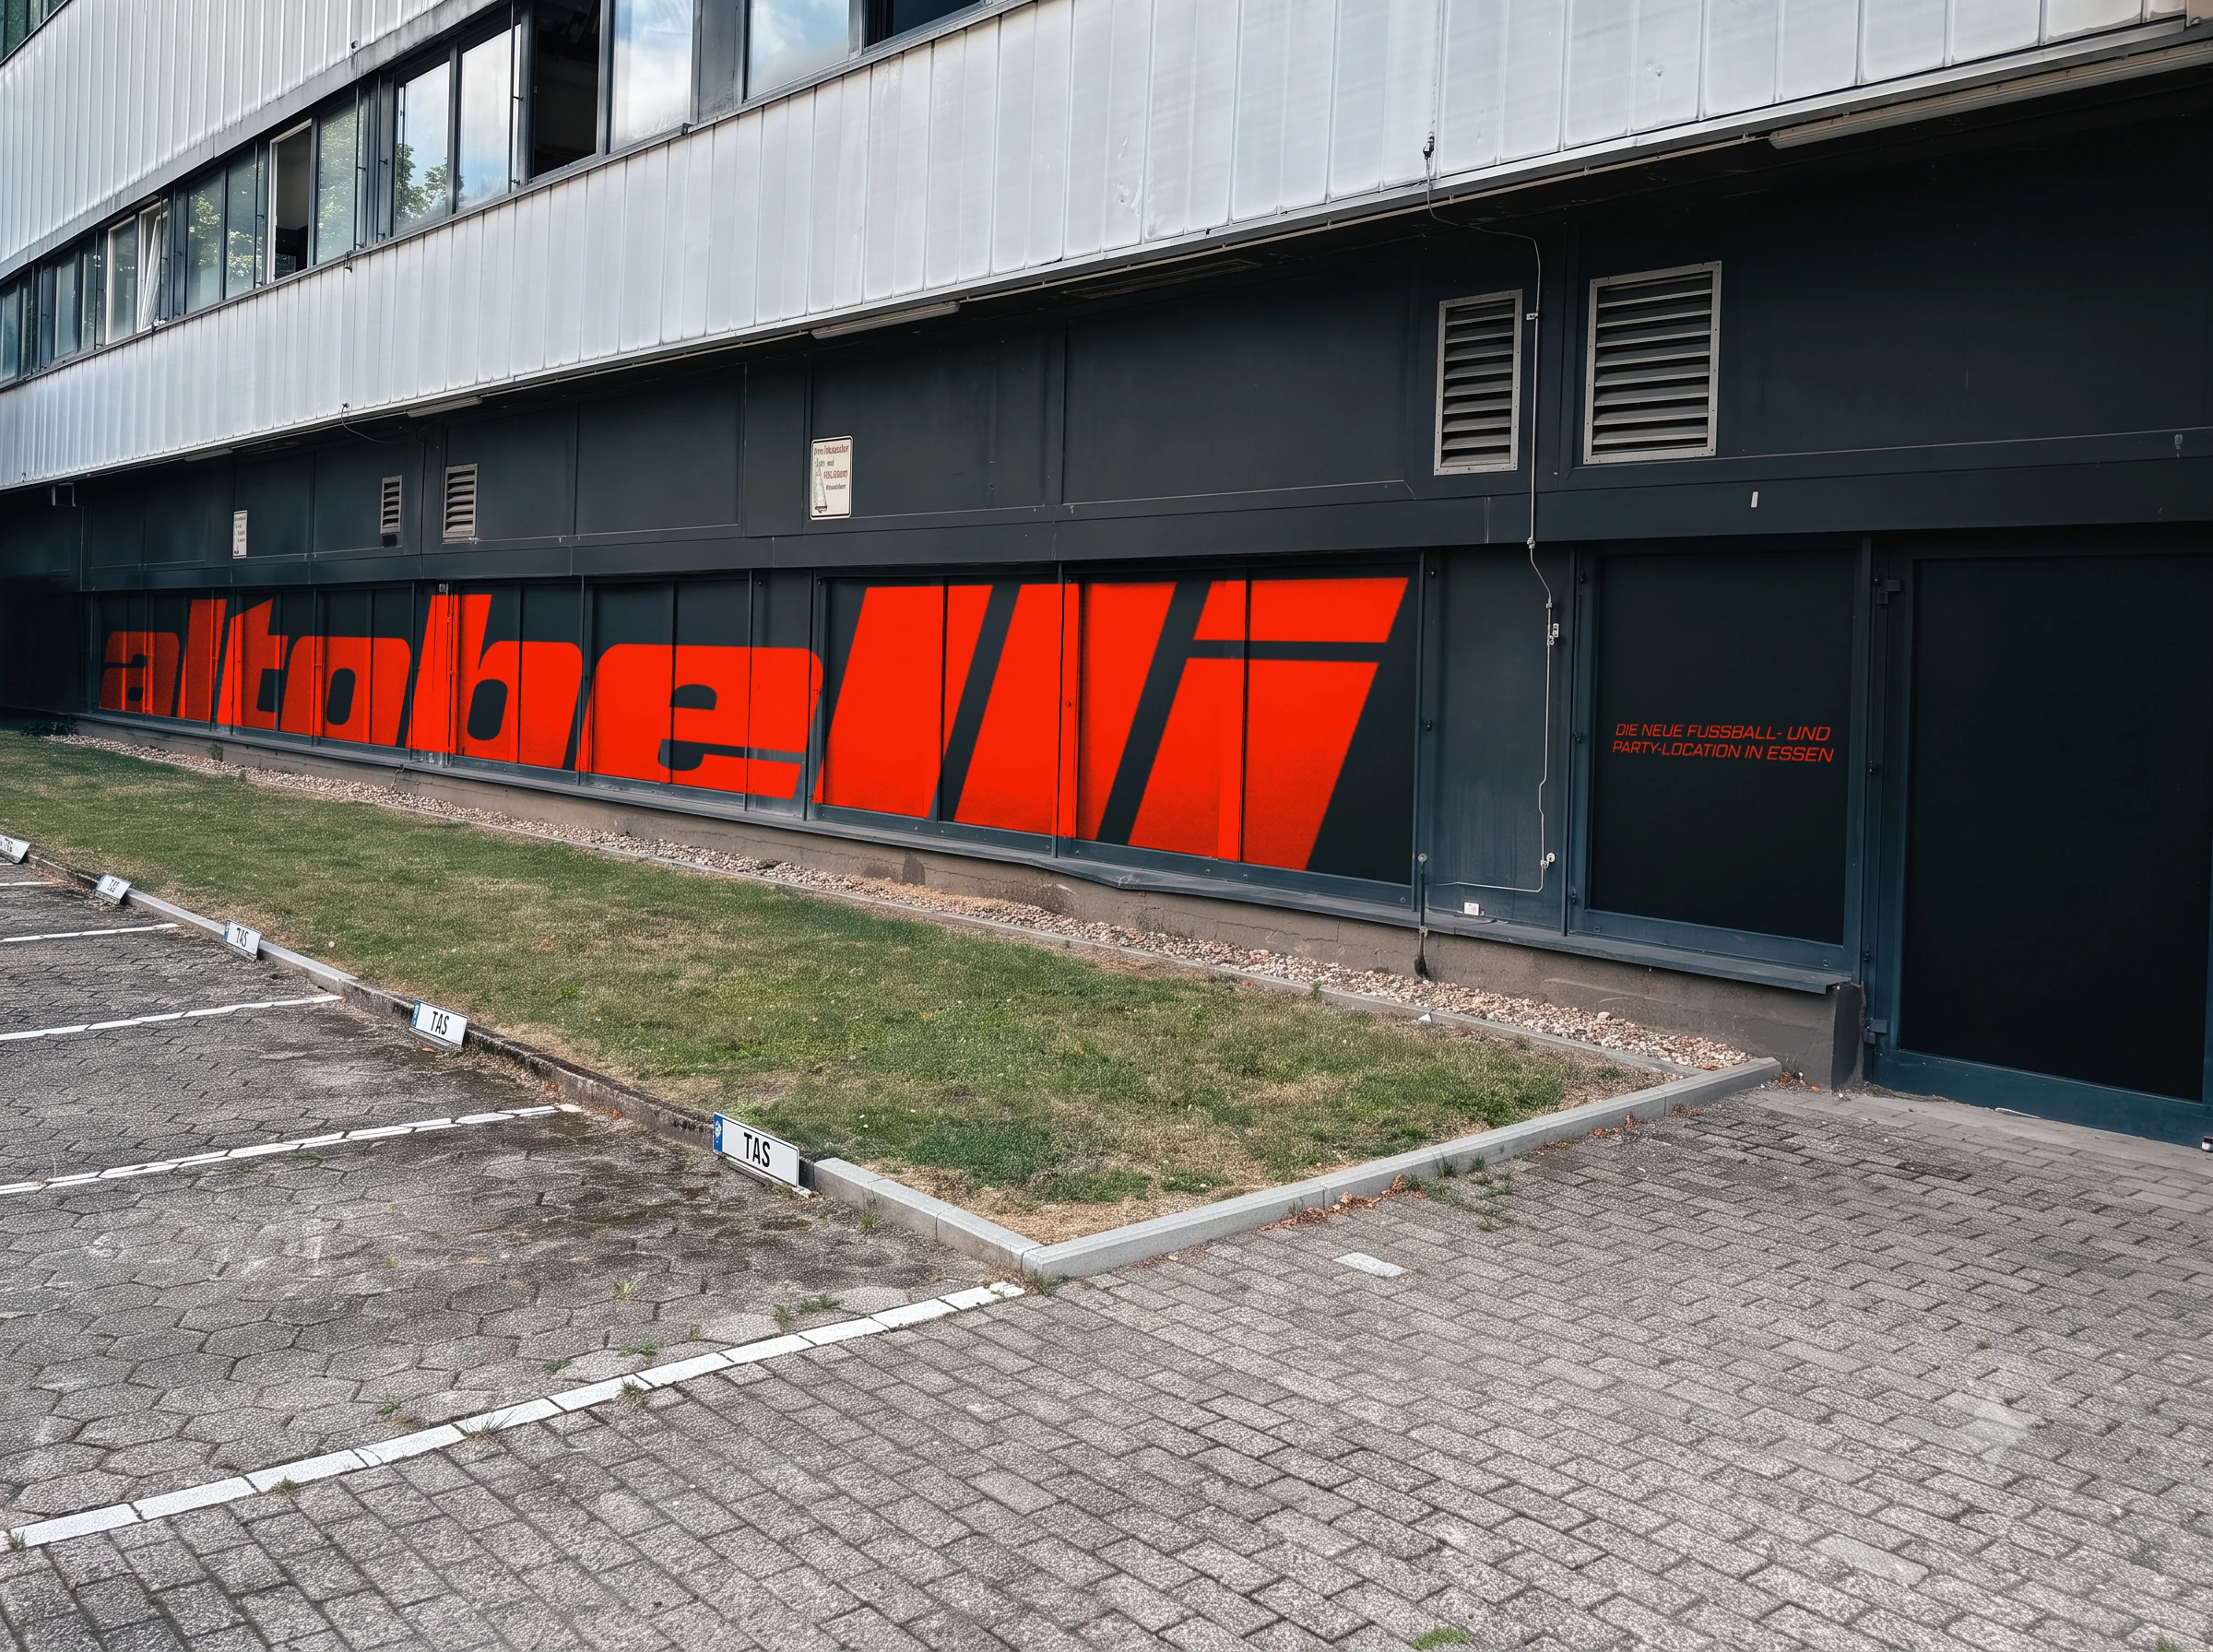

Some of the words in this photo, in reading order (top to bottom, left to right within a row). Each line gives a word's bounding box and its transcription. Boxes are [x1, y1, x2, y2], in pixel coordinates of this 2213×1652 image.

[99, 578, 1409, 871] altobelli
[1615, 724, 1639, 737] DIE
[1641, 724, 1685, 738] NEUE
[1686, 725, 1782, 740] FUSSBALL-
[1787, 726, 1831, 741] UND
[1612, 740, 1742, 759] PARTY-LOCATION
[1745, 746, 1763, 760] IN
[1766, 746, 1834, 762] ESSEN
[431, 1010, 450, 1035] TAS
[743, 1131, 771, 1168] TAS
